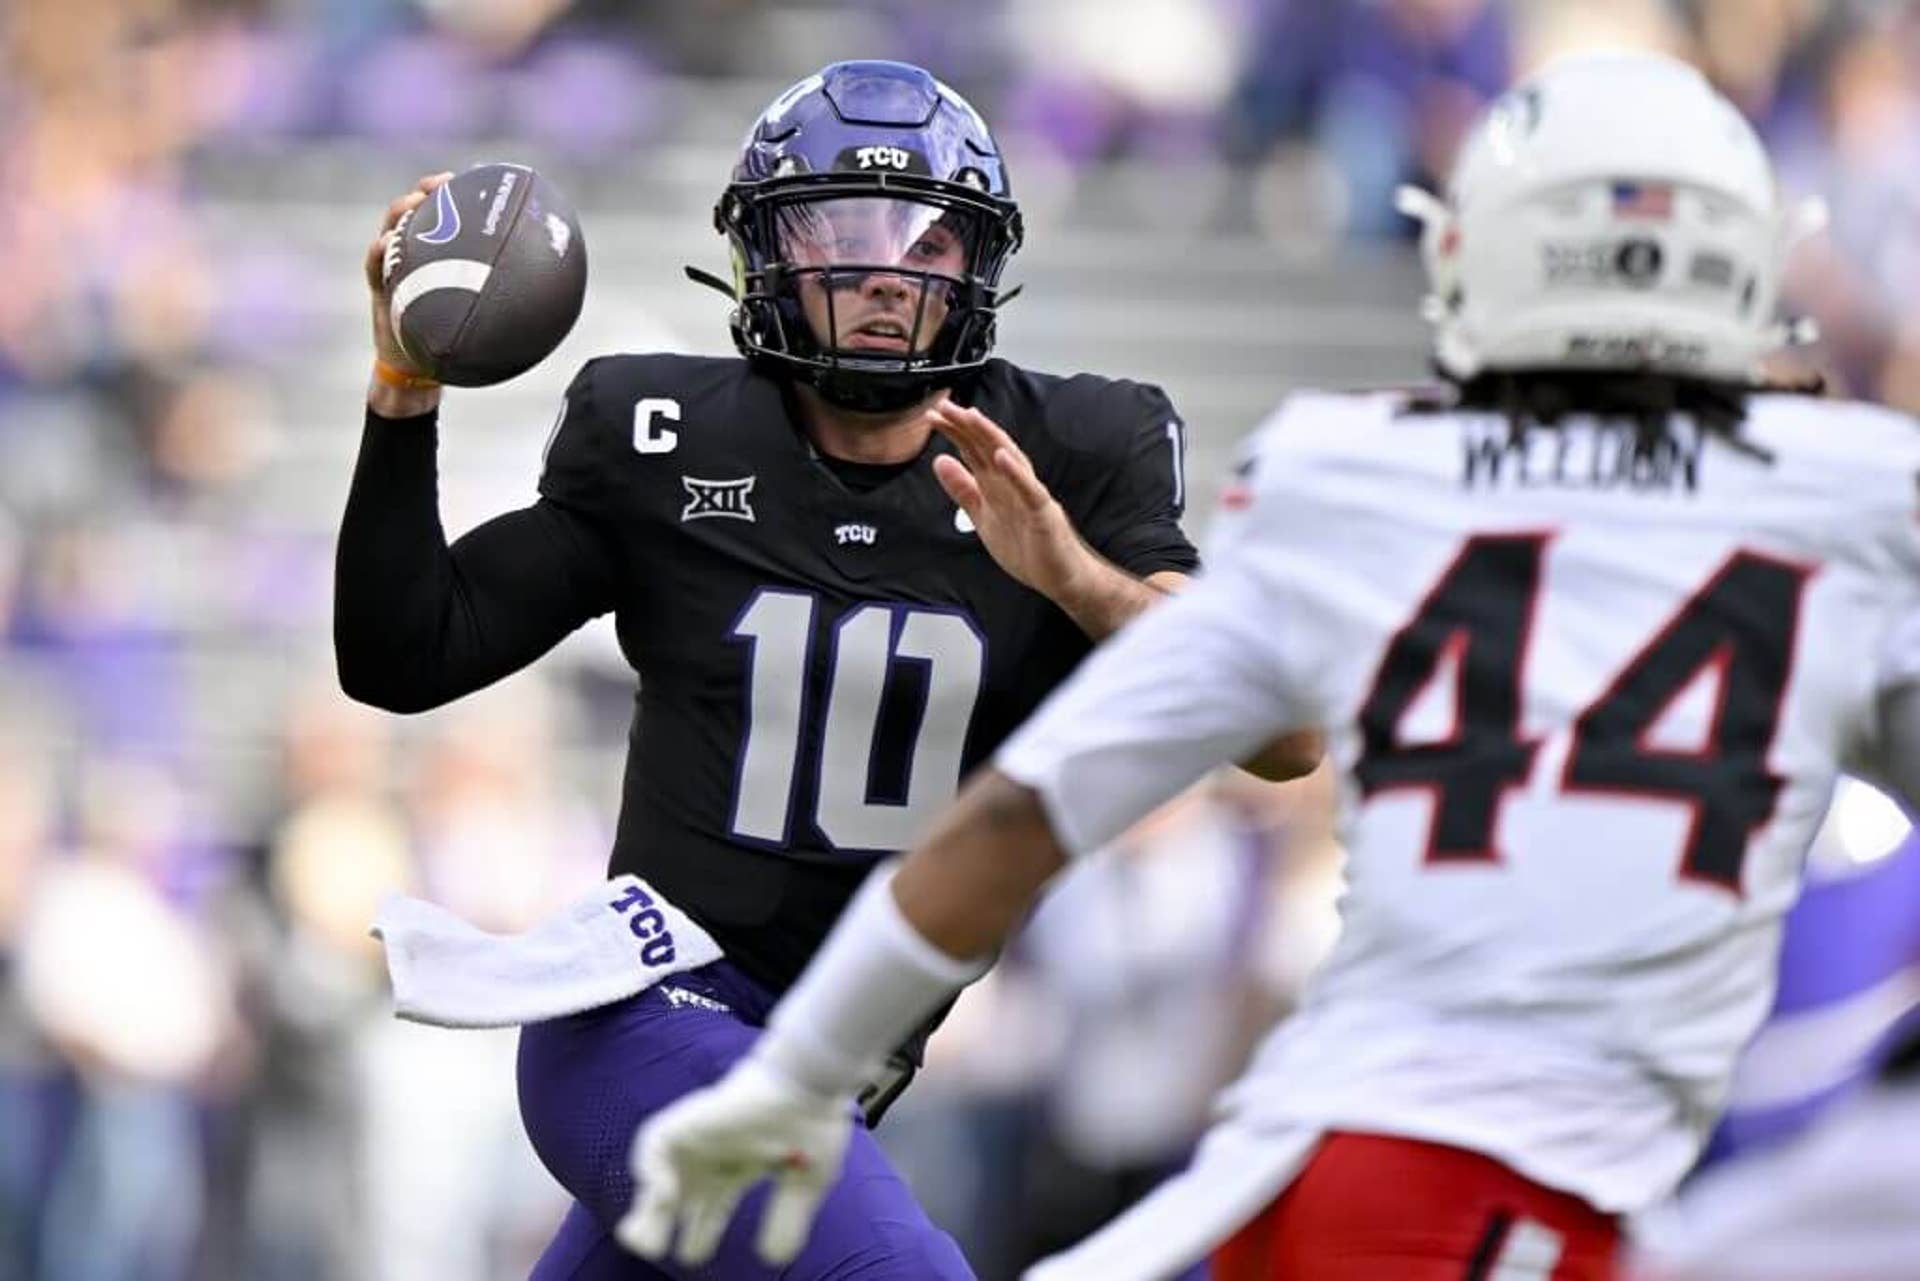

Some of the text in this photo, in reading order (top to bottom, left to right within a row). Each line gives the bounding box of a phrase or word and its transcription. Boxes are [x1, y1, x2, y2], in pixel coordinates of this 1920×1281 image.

[855, 146, 909, 169] TCU
[632, 398, 681, 454] C
[834, 524, 877, 545] TCU
[727, 585, 988, 854] 10
[1352, 528, 1823, 902] 44
[609, 885, 676, 968] TCU
